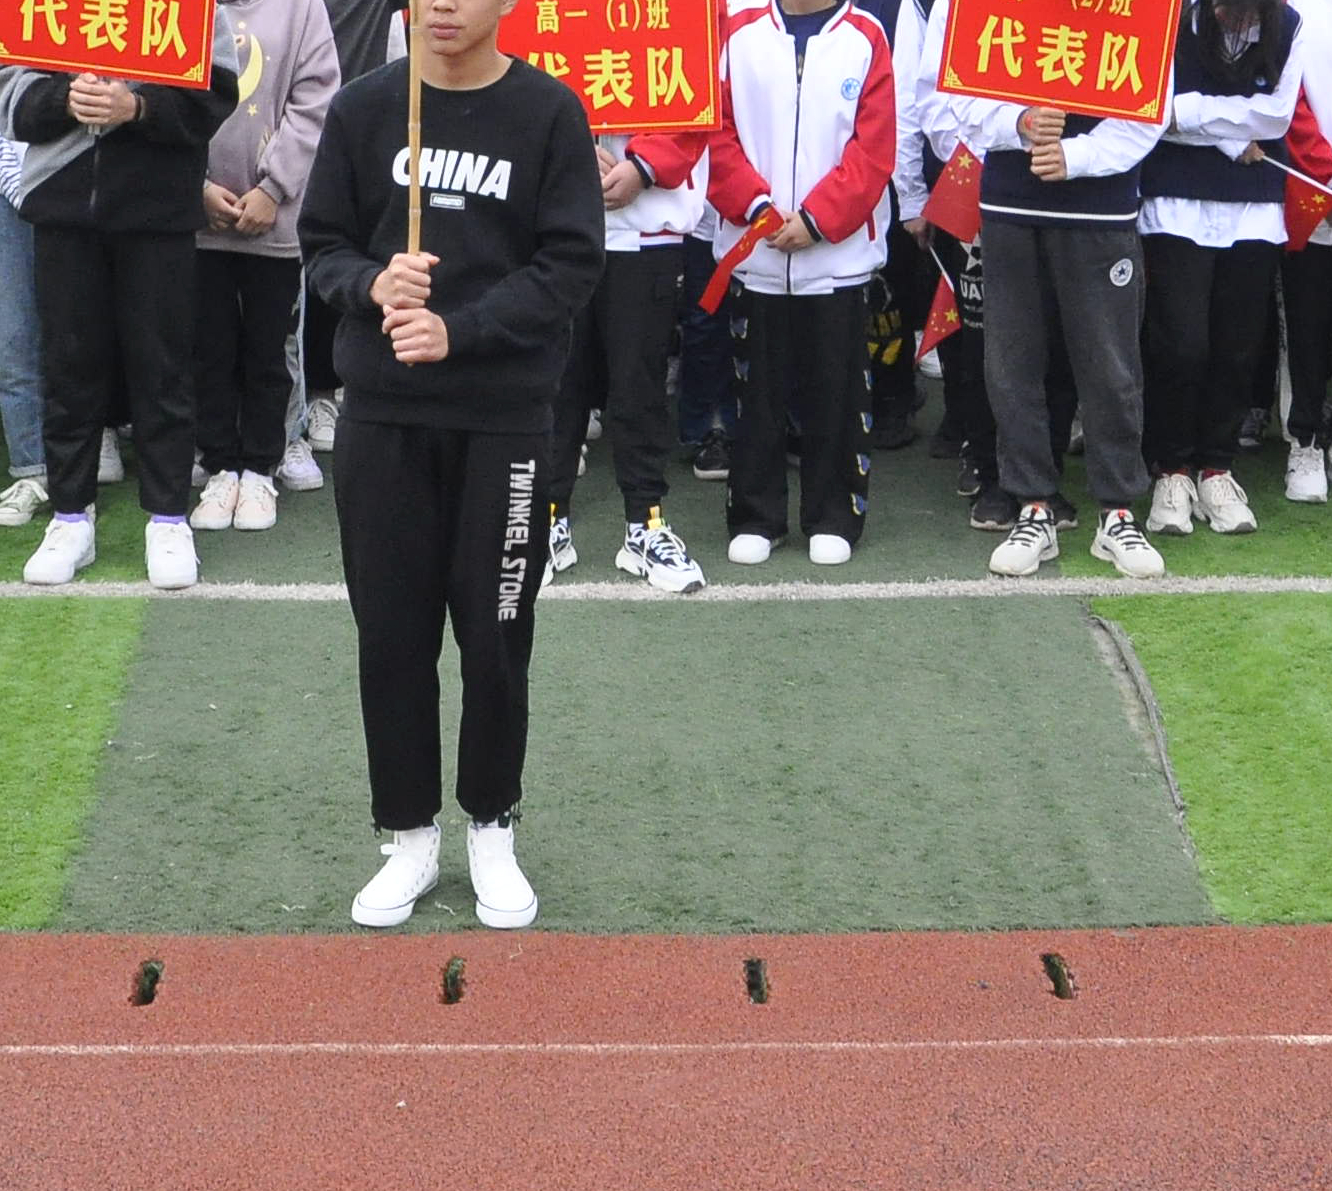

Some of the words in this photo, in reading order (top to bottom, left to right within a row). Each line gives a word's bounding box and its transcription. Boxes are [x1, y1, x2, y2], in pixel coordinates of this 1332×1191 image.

[977, 15, 1143, 95] 代表队
[392, 146, 512, 201] CHINA
[497, 556, 528, 622] STONE
